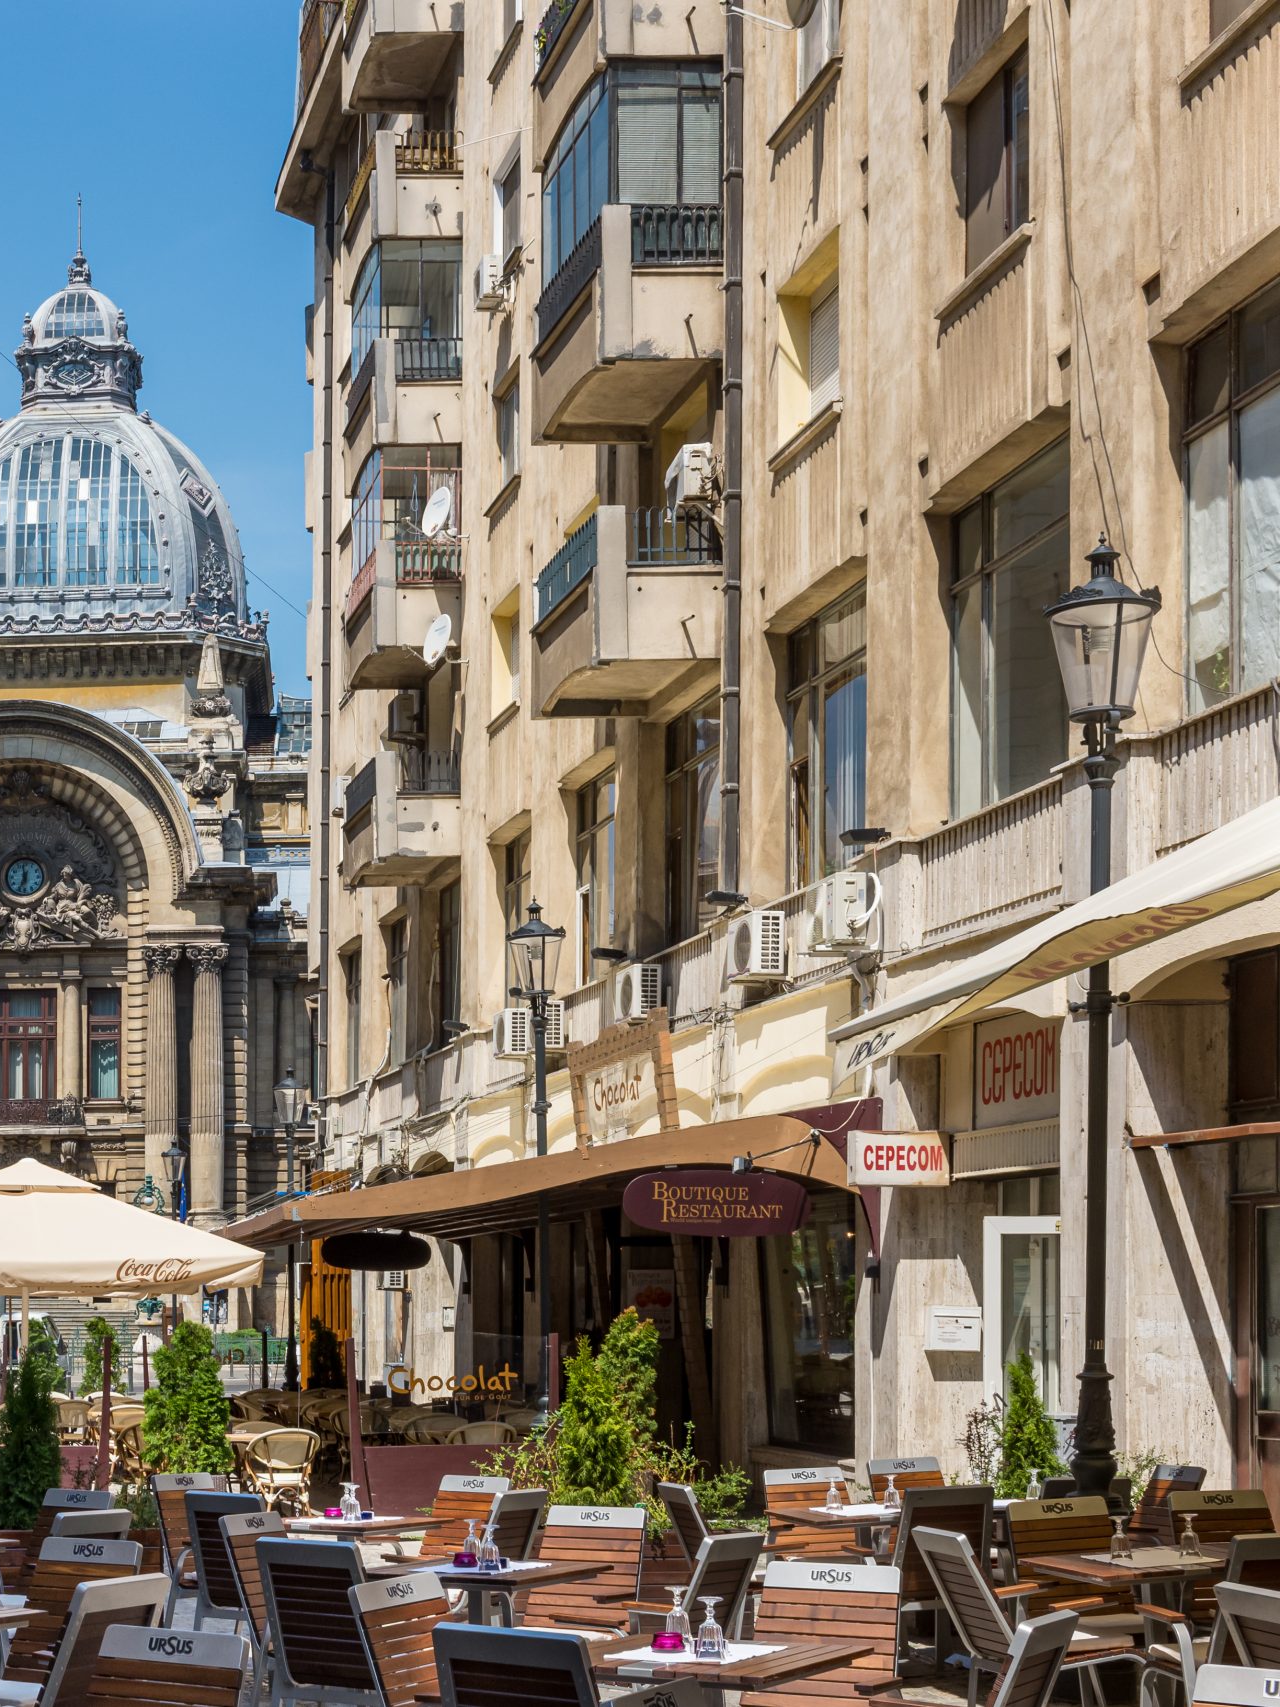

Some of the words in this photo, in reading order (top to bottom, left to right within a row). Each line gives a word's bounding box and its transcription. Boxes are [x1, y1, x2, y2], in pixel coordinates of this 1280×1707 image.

[981, 1025, 1057, 1105] CEPECOM
[593, 1062, 642, 1112] Chocolat
[863, 1144, 943, 1172] CEPECOM
[115, 1257, 197, 1283] Coca-Cola
[387, 1362, 519, 1395] Chocolat
[892, 1460, 916, 1470] URSUS
[174, 1476, 194, 1486] URSUS
[791, 1471, 817, 1480] URSUS
[462, 1479, 485, 1489] URSUS
[66, 1493, 87, 1503] URSUS
[1203, 1494, 1234, 1505] URSUS
[1041, 1502, 1074, 1514] URSUS
[244, 1516, 265, 1529] URSUS
[580, 1511, 610, 1522] URSUS
[73, 1543, 104, 1557] URSUS
[811, 1569, 852, 1583] URSUS
[385, 1583, 414, 1598] URSUS
[148, 1636, 193, 1655] URSUS
